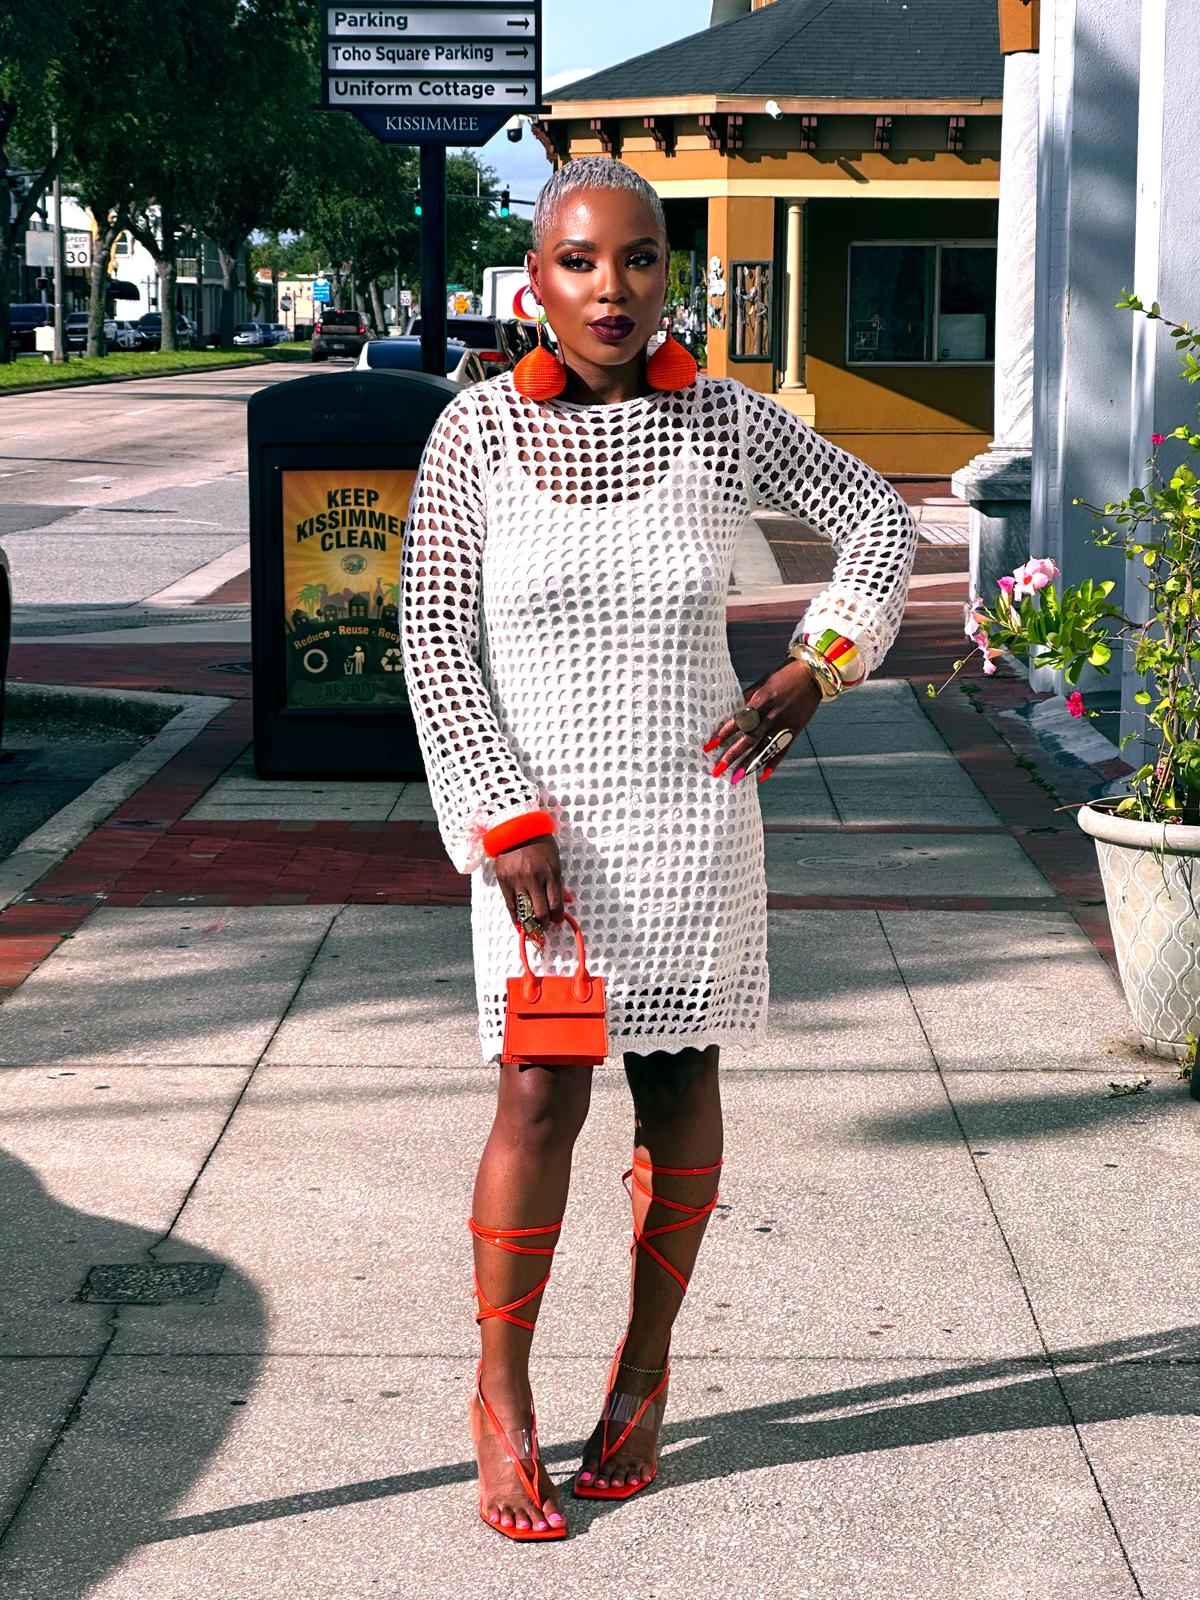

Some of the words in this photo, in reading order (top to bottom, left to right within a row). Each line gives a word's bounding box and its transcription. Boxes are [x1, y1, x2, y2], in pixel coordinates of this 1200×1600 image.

[335, 11, 408, 30] Parking
[332, 46, 371, 61] Toho
[376, 46, 430, 64] Square
[435, 43, 493, 62] Parking
[334, 80, 413, 96] Uniform
[418, 80, 495, 99] Cottage
[385, 116, 479, 131] KISSIMMEE
[66, 251, 87, 263] 30
[327, 488, 379, 509] KEEP
[320, 529, 387, 552] CLEAN
[294, 630, 330, 649] Reduce
[338, 625, 369, 635] Reuse
